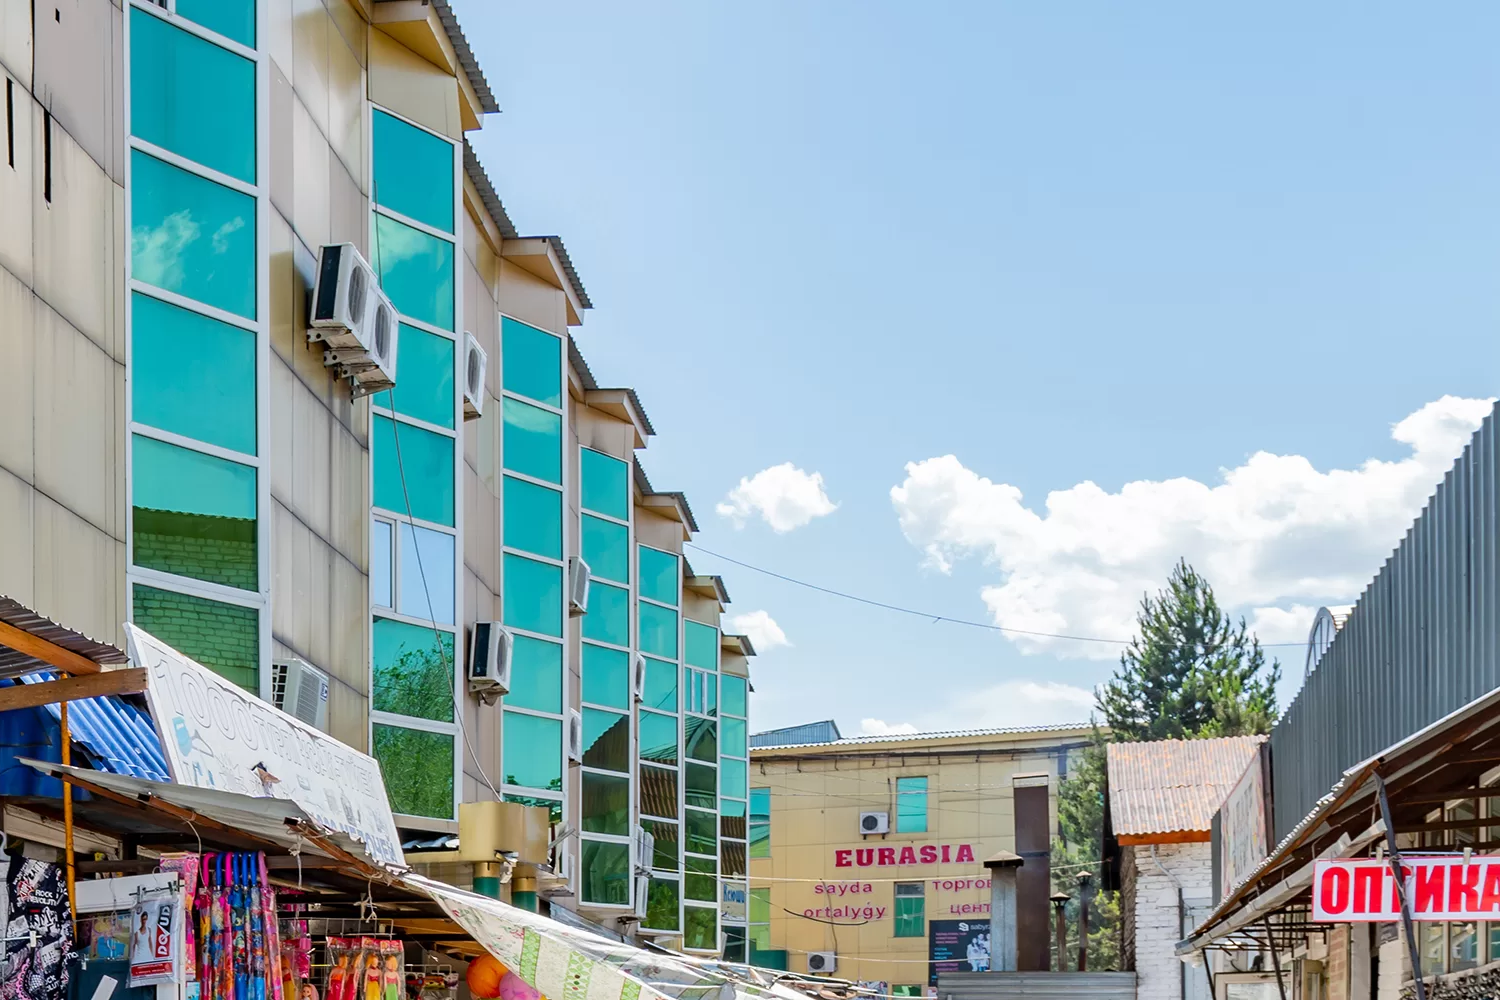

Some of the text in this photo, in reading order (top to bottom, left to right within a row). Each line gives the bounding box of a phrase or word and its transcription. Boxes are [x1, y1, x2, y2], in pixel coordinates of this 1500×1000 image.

[154, 658, 260, 751] 1000
[835, 844, 975, 868] EURASIA
[1320, 863, 1500, 915] ОПТИКА
